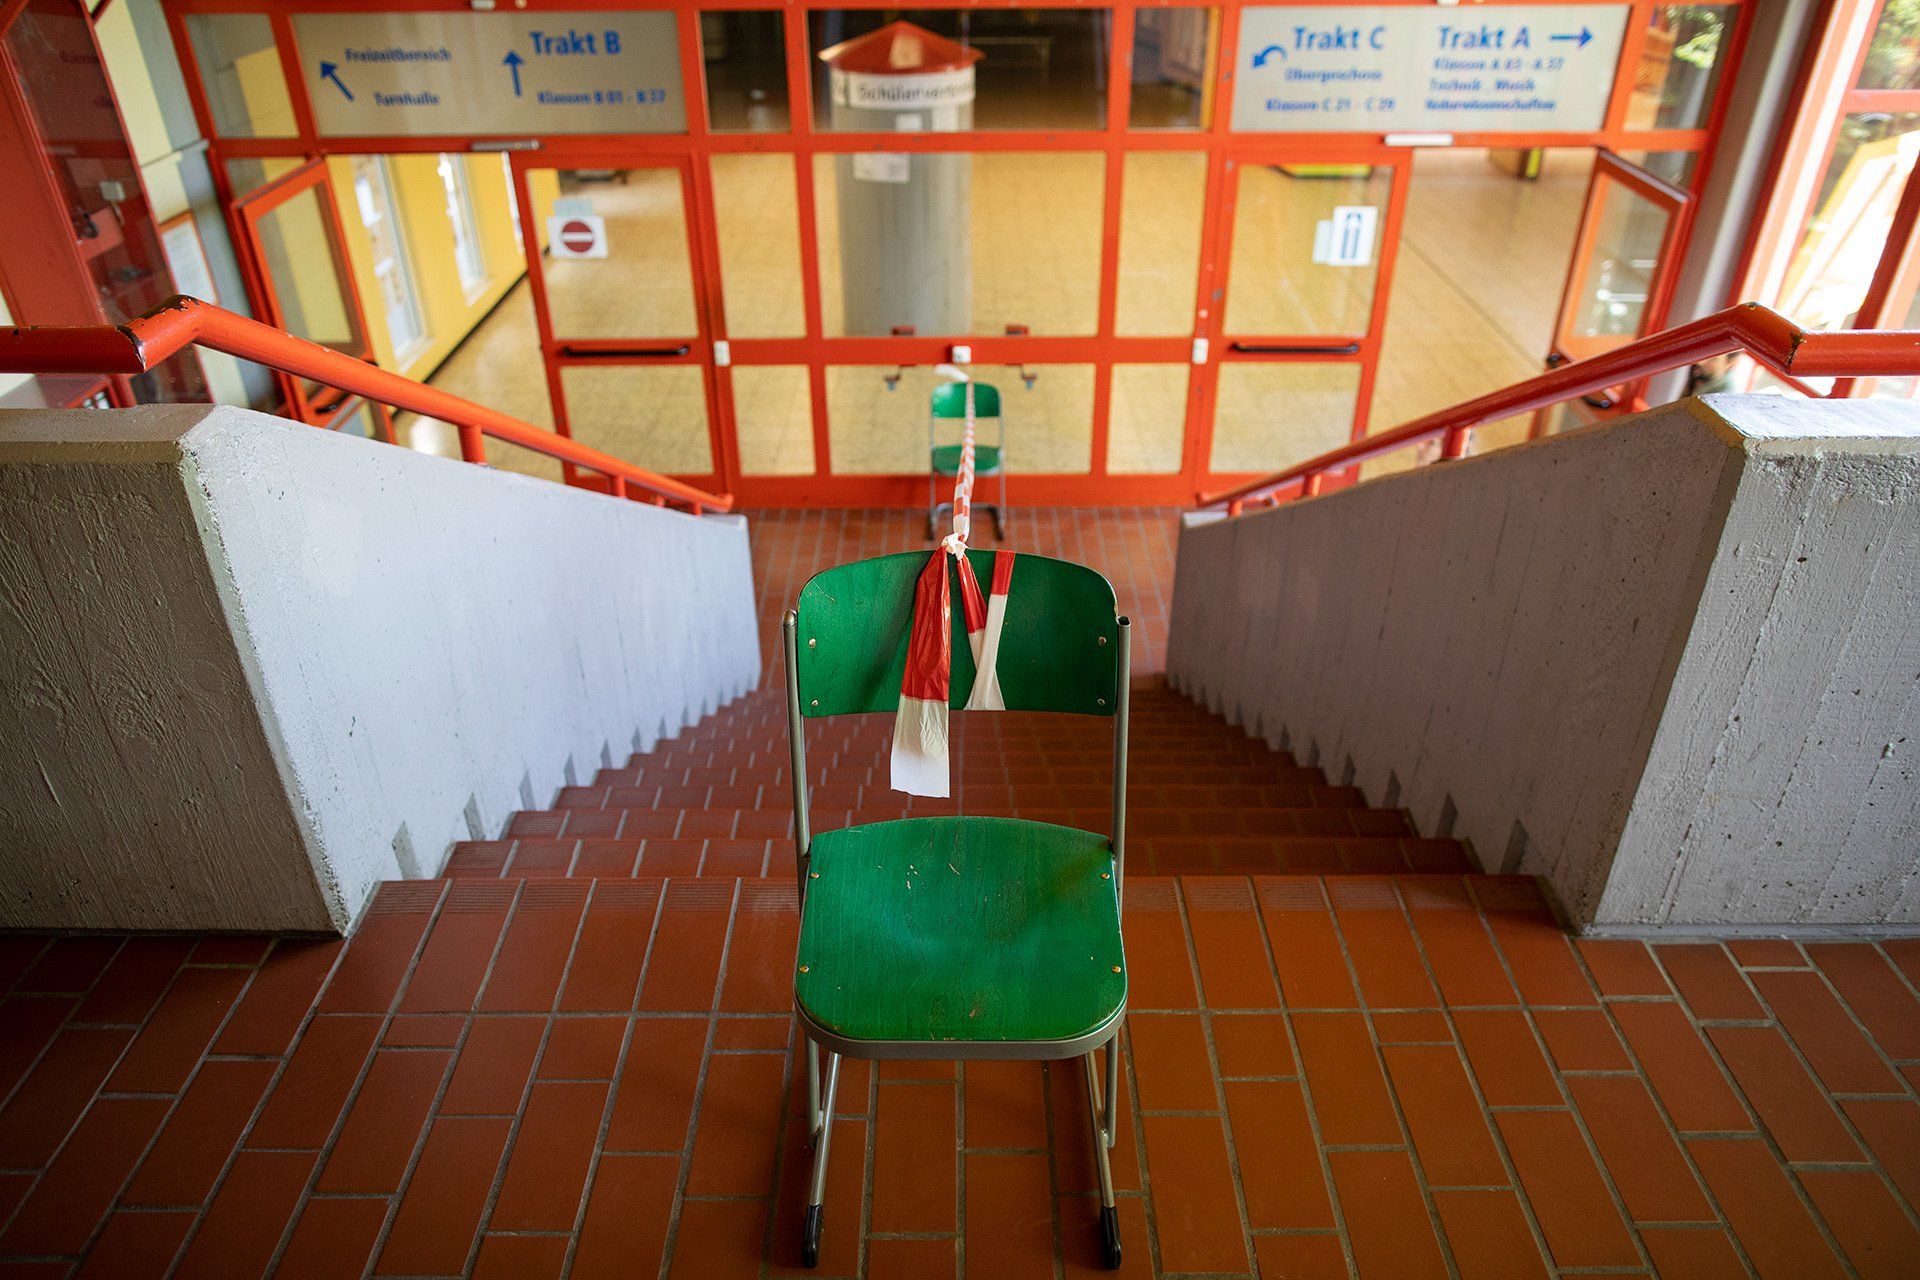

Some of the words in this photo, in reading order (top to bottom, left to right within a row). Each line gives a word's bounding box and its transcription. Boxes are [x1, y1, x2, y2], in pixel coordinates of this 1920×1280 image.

[530, 29, 597, 55] Trakt
[604, 30, 621, 54] B
[1294, 25, 1360, 50] Trakt
[1369, 26, 1386, 50] C
[1438, 25, 1504, 49] Trakt
[1511, 26, 1530, 49] A
[1433, 57, 1485, 70] Klassen
[1495, 78, 1535, 90] Musik
[374, 91, 440, 106] Turnhalle
[537, 89, 592, 105] Klassen
[1265, 97, 1319, 112] Klassen
